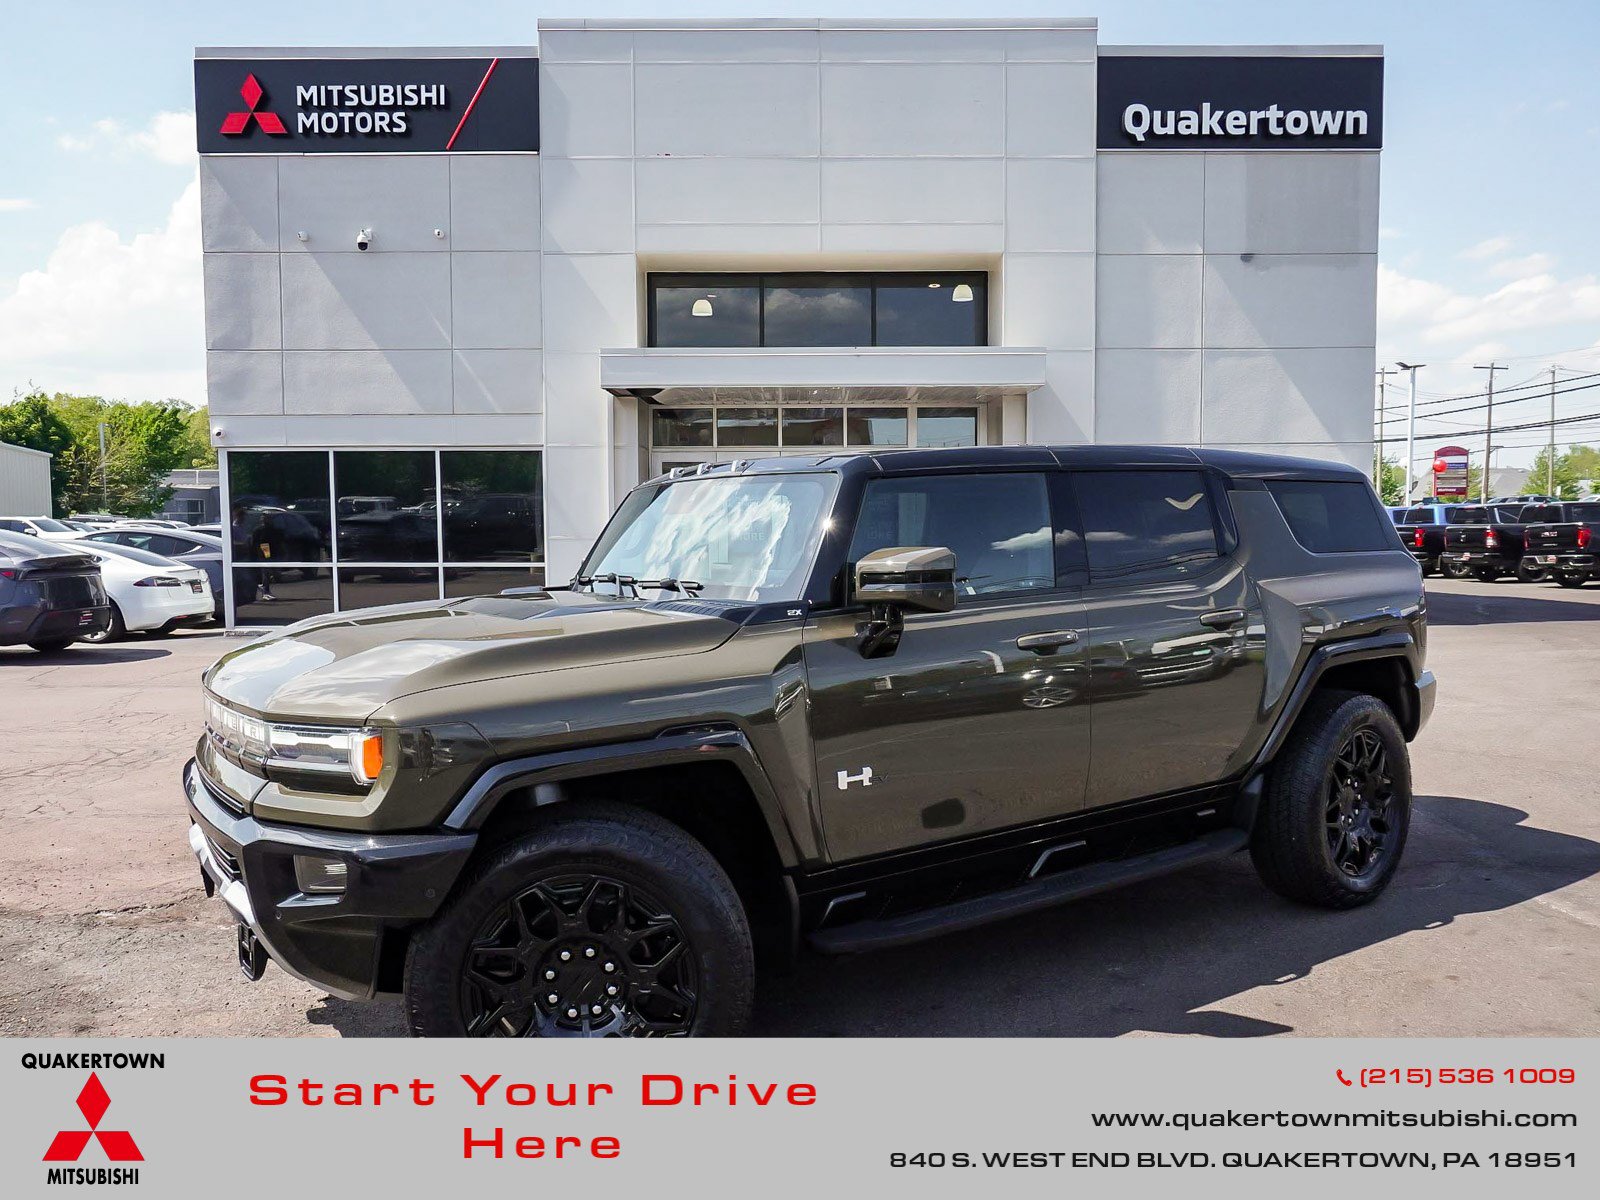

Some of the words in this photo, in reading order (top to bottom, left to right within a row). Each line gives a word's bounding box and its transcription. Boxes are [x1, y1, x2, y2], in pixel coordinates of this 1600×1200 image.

[296, 84, 445, 107] MITSUBISHI
[297, 111, 408, 134] MOTORS
[1123, 102, 1368, 142] Quakertown
